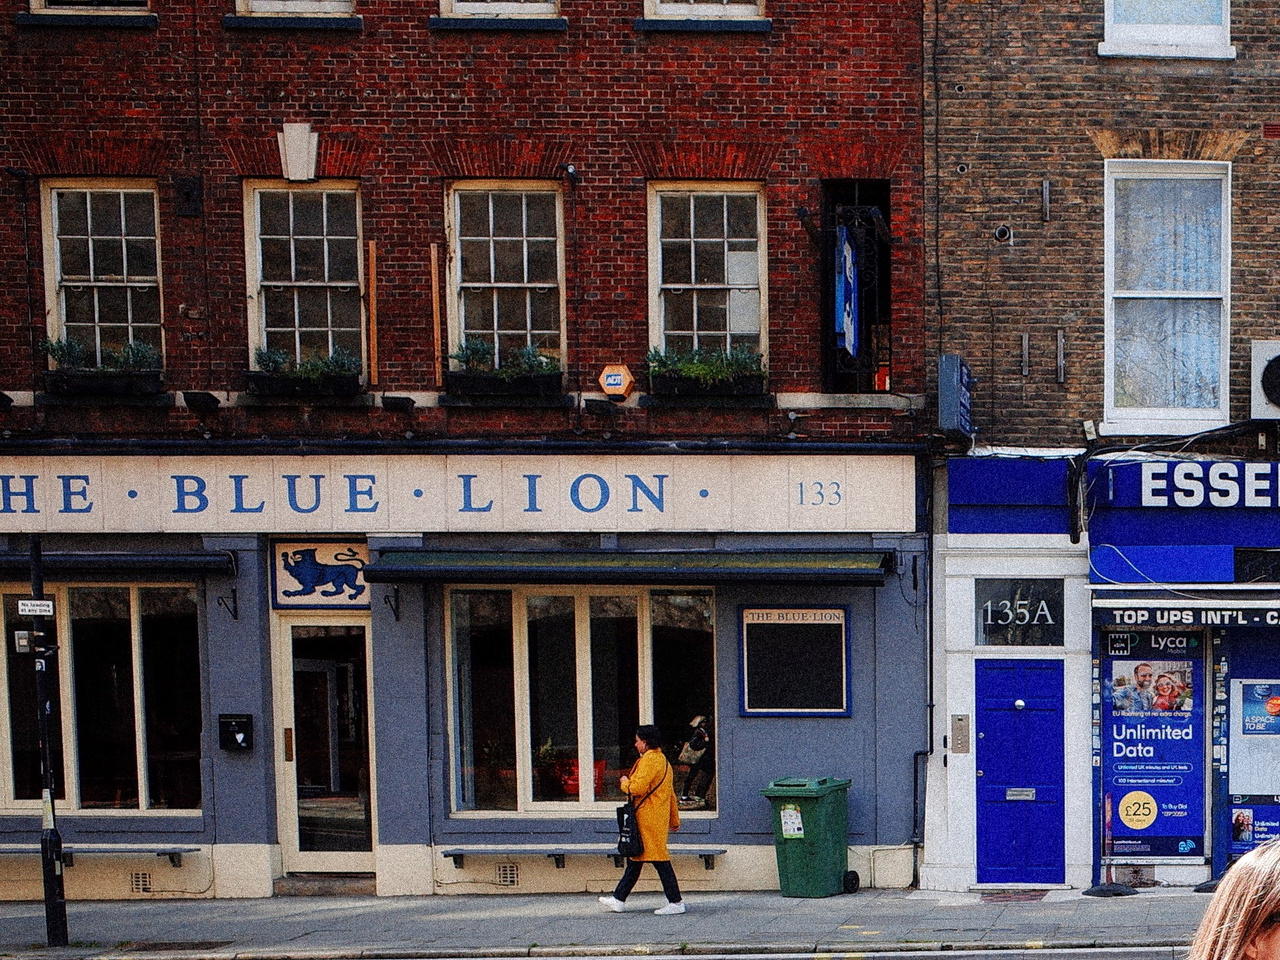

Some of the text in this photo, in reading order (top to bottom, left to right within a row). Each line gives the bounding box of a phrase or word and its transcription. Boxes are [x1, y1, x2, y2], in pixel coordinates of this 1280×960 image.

[171, 475, 380, 513] BLUE
[458, 474, 669, 513] LION
[797, 481, 842, 506] 133
[749, 612, 841, 621] THE BLUE LION
[983, 600, 1055, 625] 135A
[1113, 610, 1149, 624] TOP
[1156, 610, 1194, 624] UPS
[1201, 610, 1248, 625] INT'L
[1151, 634, 1187, 650] Lyca
[1113, 724, 1193, 740] Unlimited
[1113, 742, 1154, 757] Data
[1125, 802, 1151, 816] £25
